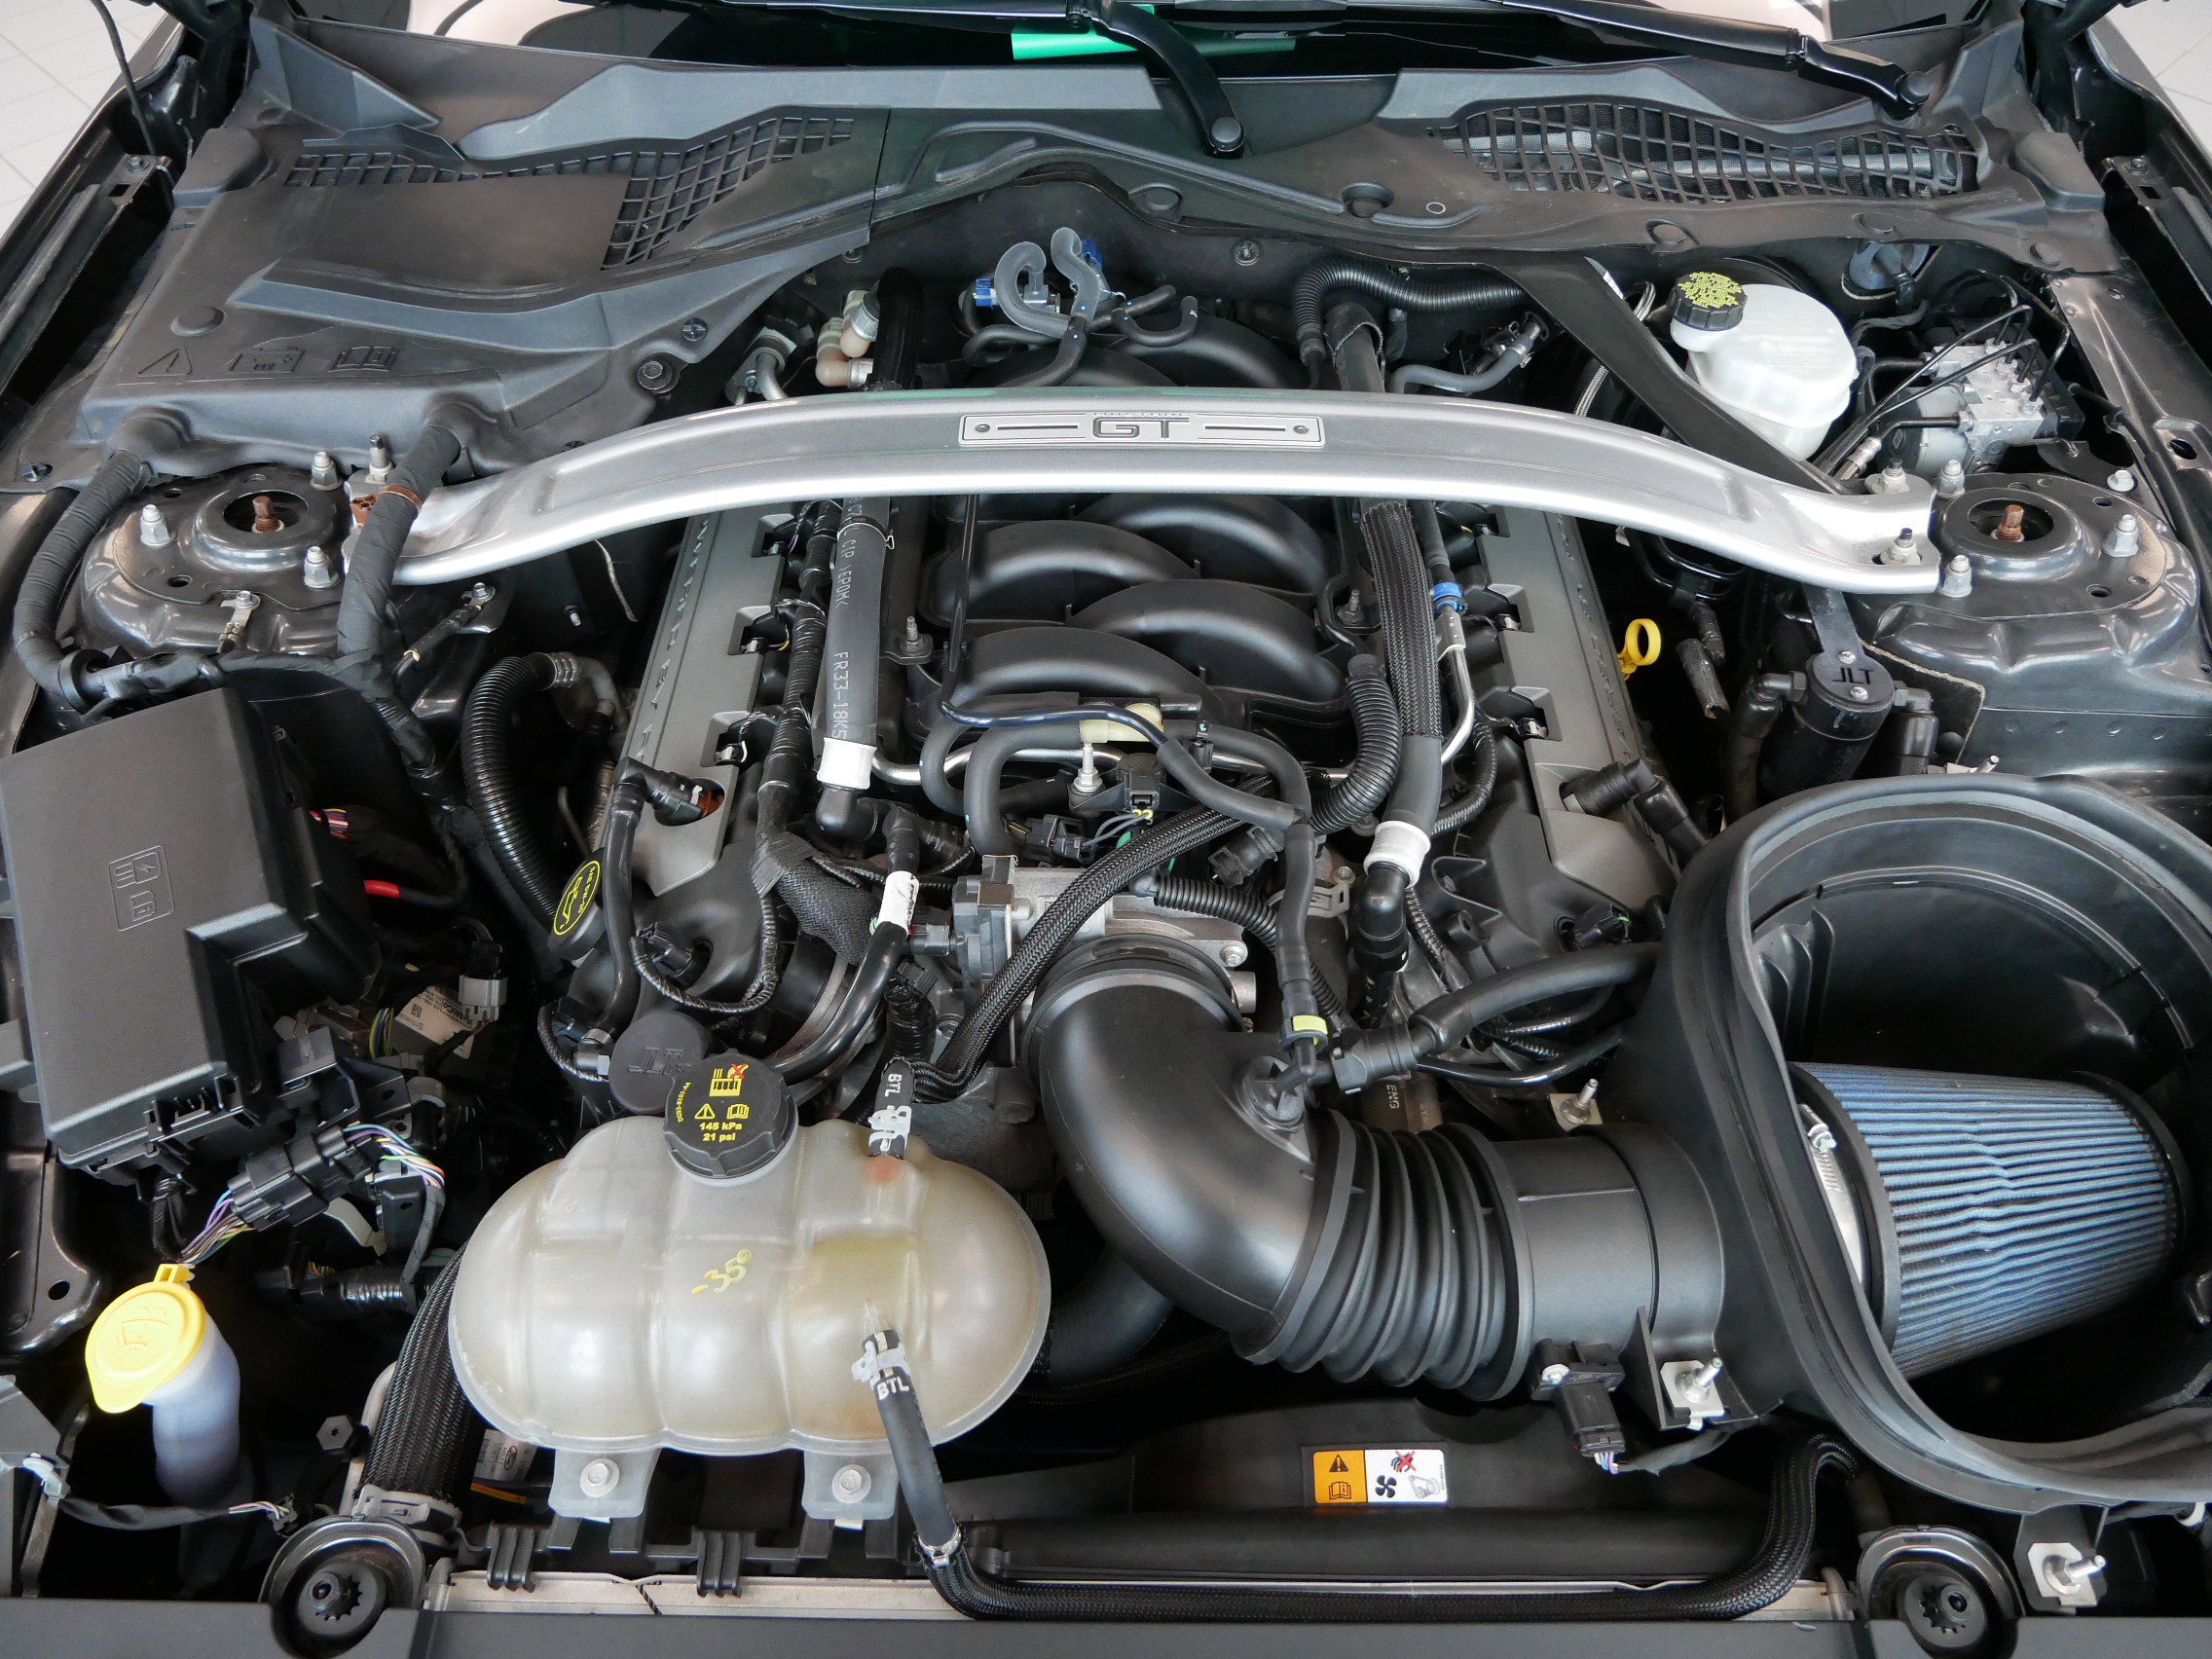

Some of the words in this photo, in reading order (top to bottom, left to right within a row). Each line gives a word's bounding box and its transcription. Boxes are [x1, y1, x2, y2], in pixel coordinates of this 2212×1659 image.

[1092, 417, 1190, 439] GT
[1831, 666, 1874, 685] JLT
[884, 1073, 903, 1097] BTL
[1385, 1084, 1400, 1109] ENG
[699, 1122, 720, 1131] 145
[721, 1122, 743, 1131] kPa
[702, 1132, 718, 1142] 21
[719, 1131, 737, 1143] psi
[876, 1376, 910, 1401] BTL
